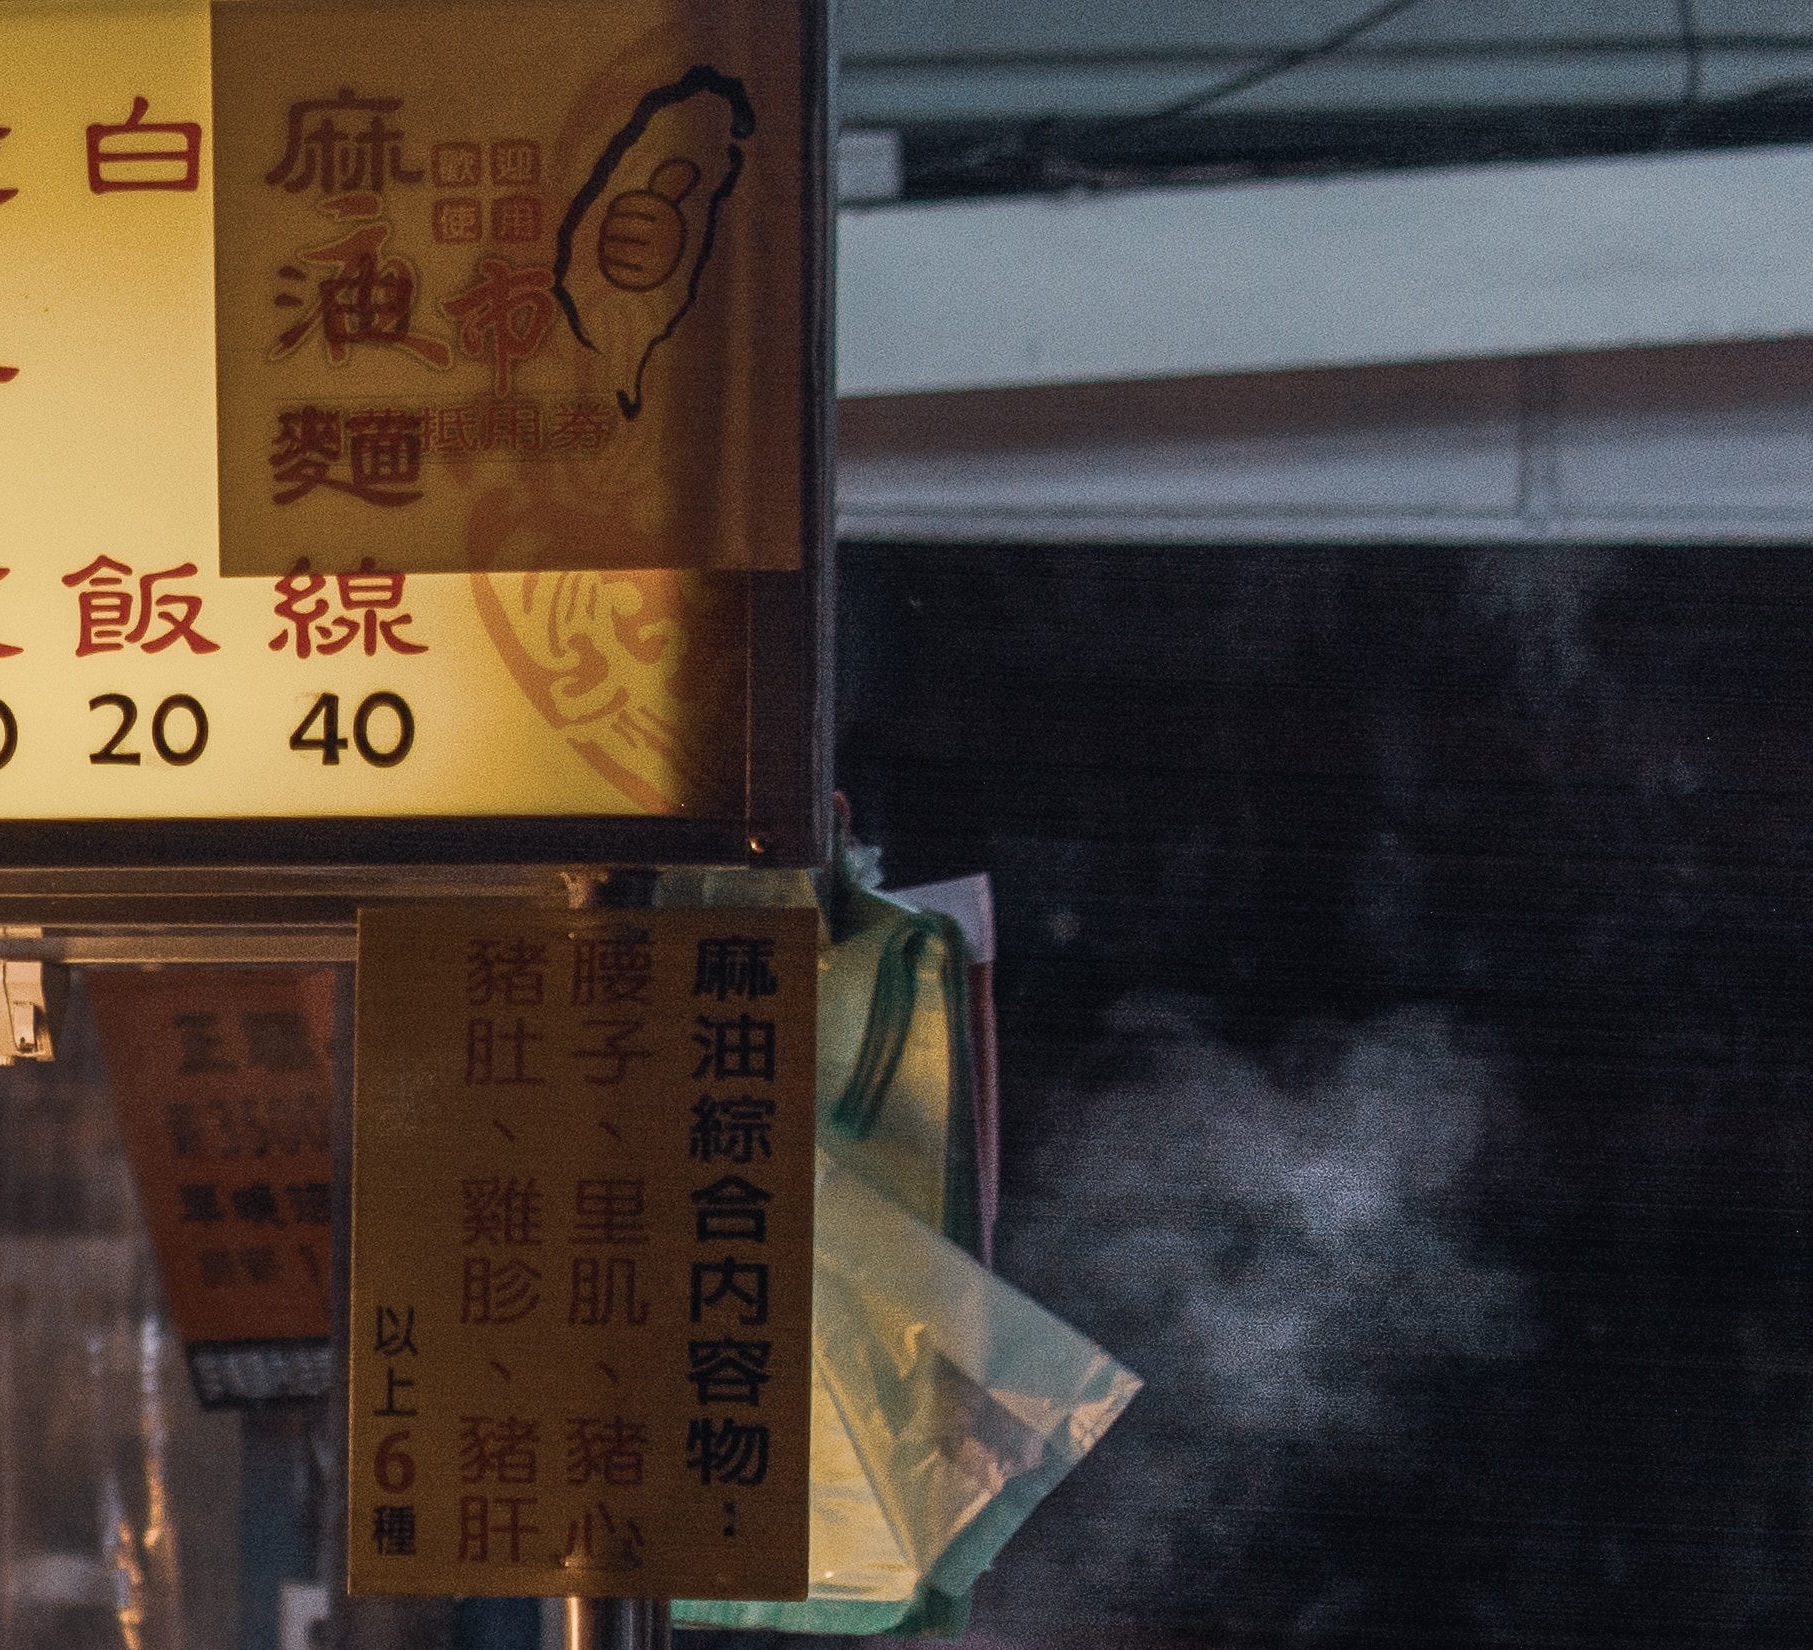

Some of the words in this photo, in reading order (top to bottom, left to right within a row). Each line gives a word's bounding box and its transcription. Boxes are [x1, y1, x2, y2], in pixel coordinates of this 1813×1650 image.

[58, 95, 225, 662] 白飯
[90, 693, 208, 765] 20
[290, 691, 414, 767] 40
[372, 1304, 418, 1557] 以上6種
